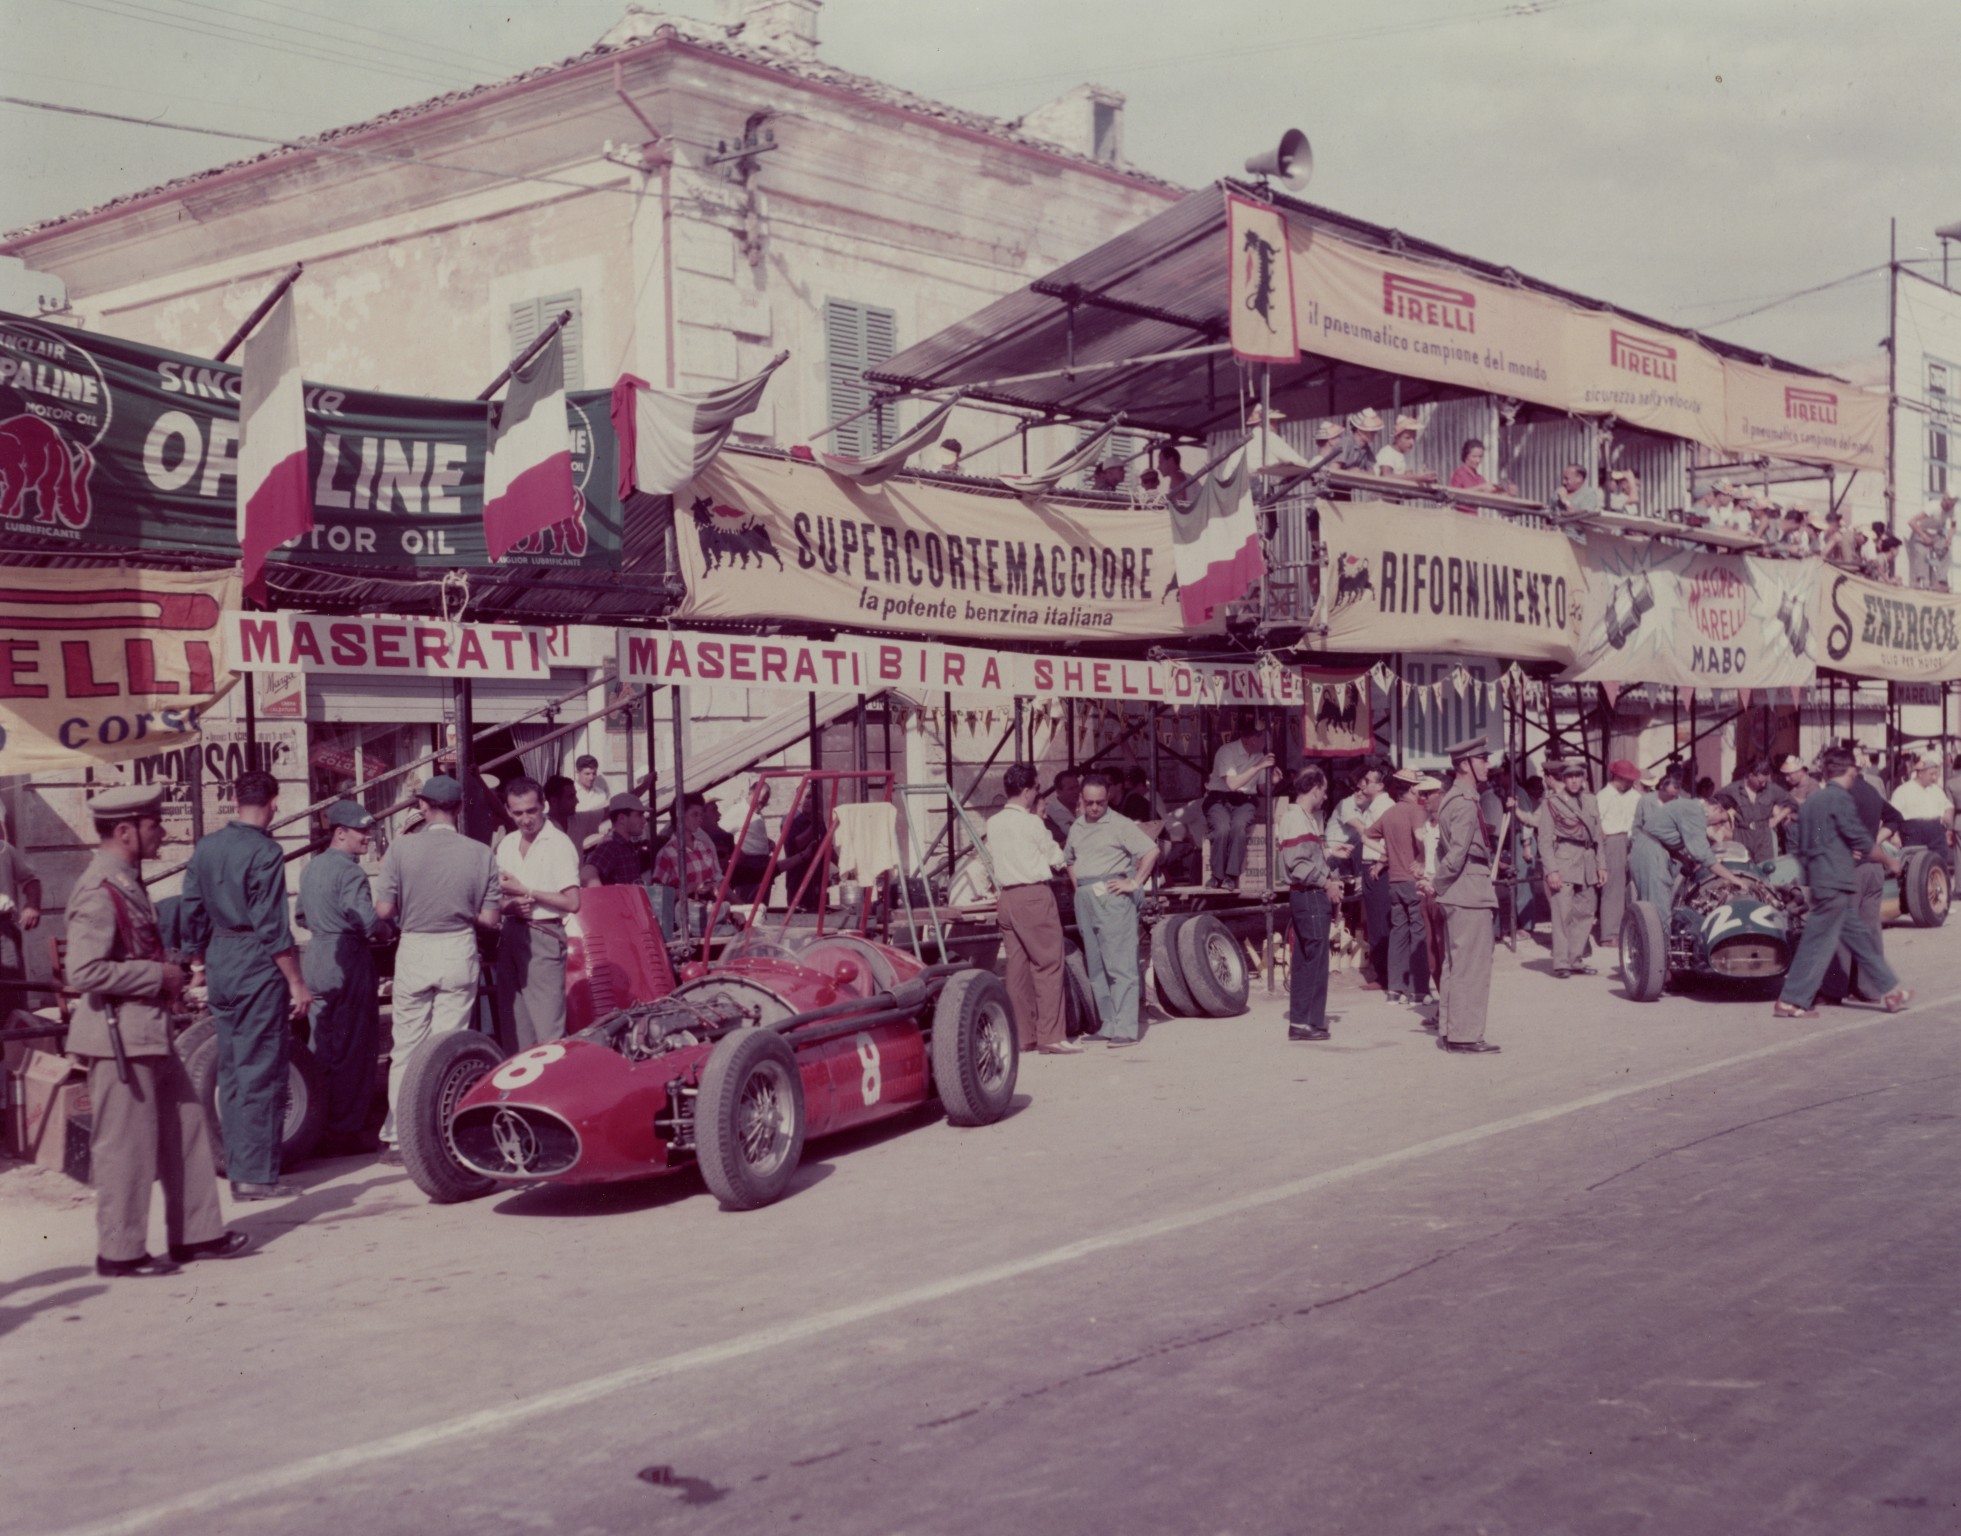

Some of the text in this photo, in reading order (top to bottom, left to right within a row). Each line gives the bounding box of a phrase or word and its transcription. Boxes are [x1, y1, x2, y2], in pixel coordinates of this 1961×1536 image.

[1383, 271, 1476, 334] PIRELLI
[0, 333, 66, 361] INCLAIR
[1308, 300, 1548, 382] il pneumatico campione del mondo
[1610, 329, 1677, 382] PIRELLI
[0, 356, 98, 405] PALINE
[157, 361, 346, 417] SINCIR
[24, 401, 98, 428] MOTOR OIL
[1785, 386, 1838, 425] PIRELLI
[143, 411, 467, 514] OPLINE
[571, 461, 585, 472] OIL
[5, 521, 81, 540] LUBRIFICANTE
[283, 524, 456, 555] TOR OIL
[531, 556, 581, 566] LUBRIFICANTE
[793, 511, 1153, 600] SUPERCORTEMAGGIORE
[858, 586, 1114, 628] la potente benzina italiana
[1379, 550, 1566, 630] RIFORNIMENTO
[239, 618, 541, 672] MASERATI
[629, 636, 860, 686] MASERATI
[1690, 645, 1747, 674] MABO
[1033, 658, 1165, 697] SHELL
[1175, 667, 1292, 699] DPONE
[318, 755, 377, 777] COLGE
[491, 1043, 567, 1091] 8
[856, 1030, 881, 1107] 8
